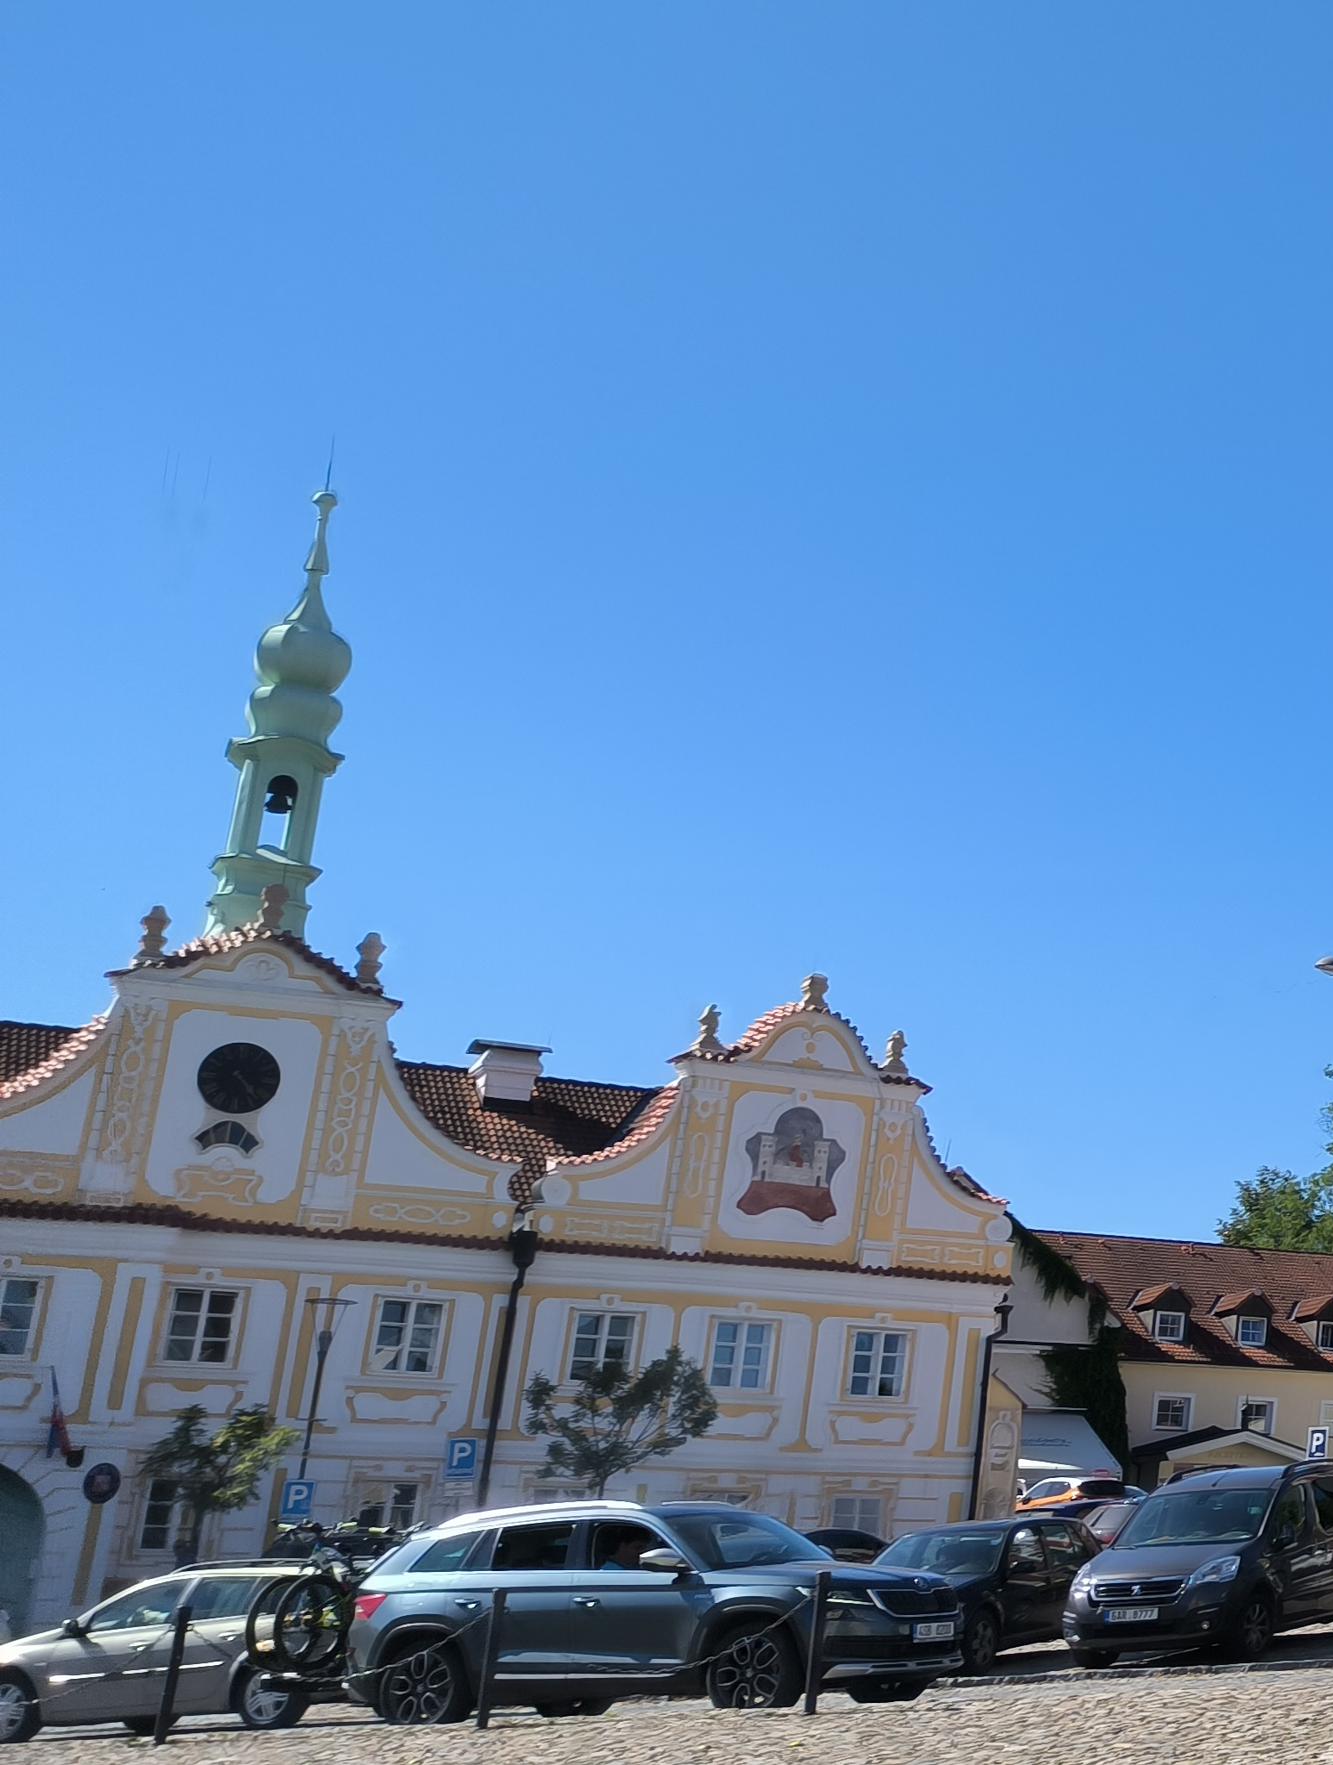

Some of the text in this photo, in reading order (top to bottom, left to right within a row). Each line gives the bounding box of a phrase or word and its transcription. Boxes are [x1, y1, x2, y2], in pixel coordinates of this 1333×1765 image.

[450, 1442, 472, 1467] P
[1310, 1432, 1324, 1453] P
[287, 1484, 309, 1509] P
